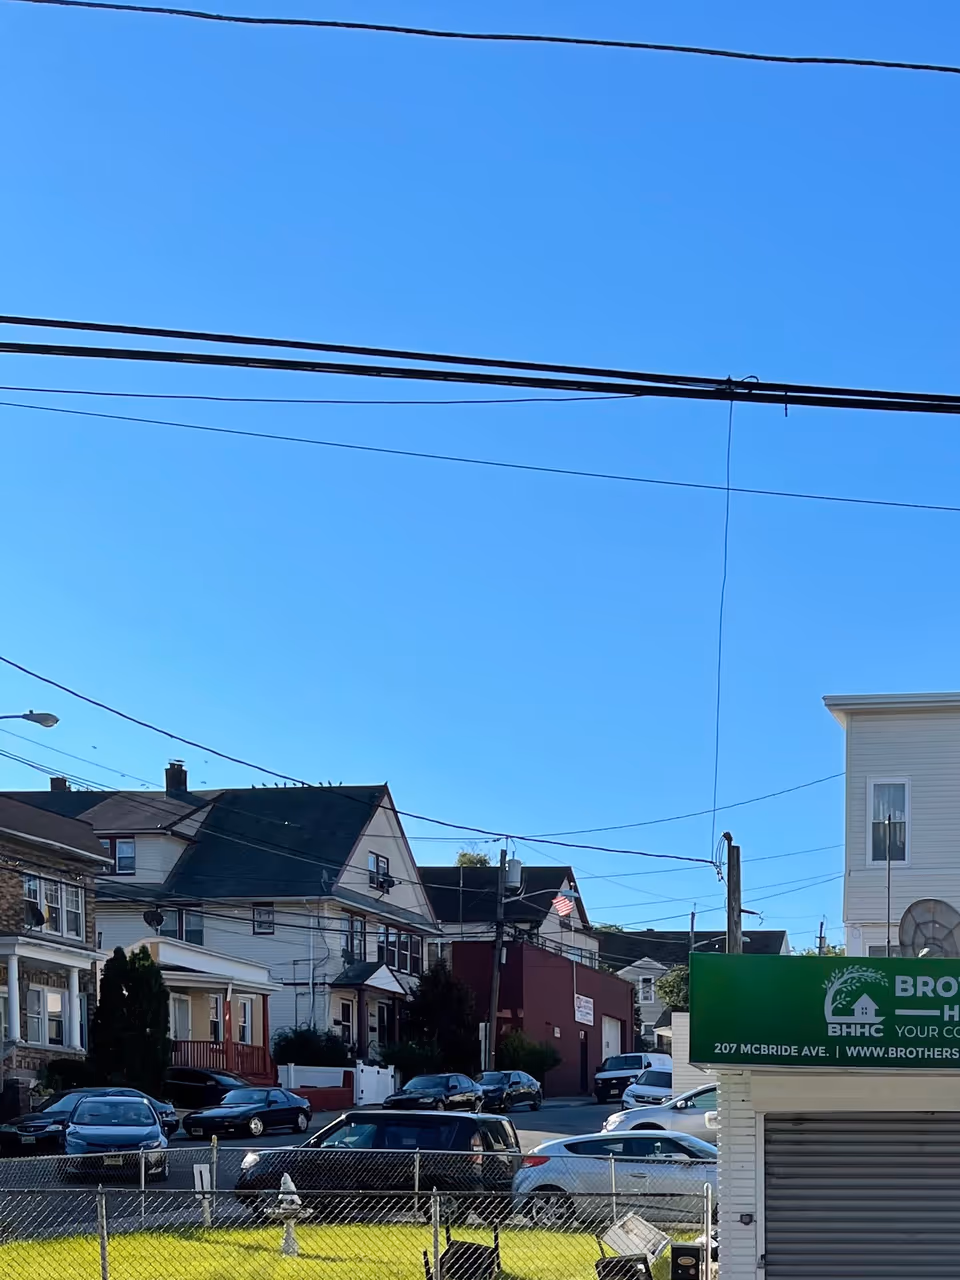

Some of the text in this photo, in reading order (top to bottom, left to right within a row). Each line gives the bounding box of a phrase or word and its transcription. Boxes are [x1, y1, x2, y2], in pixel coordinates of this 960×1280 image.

[827, 1024, 884, 1037] BHHC
[895, 1025, 939, 1038] YOUR
[714, 1043, 738, 1054] 207
[740, 1044, 799, 1056] MCBRIDE
[801, 1046, 830, 1057] AVE.
